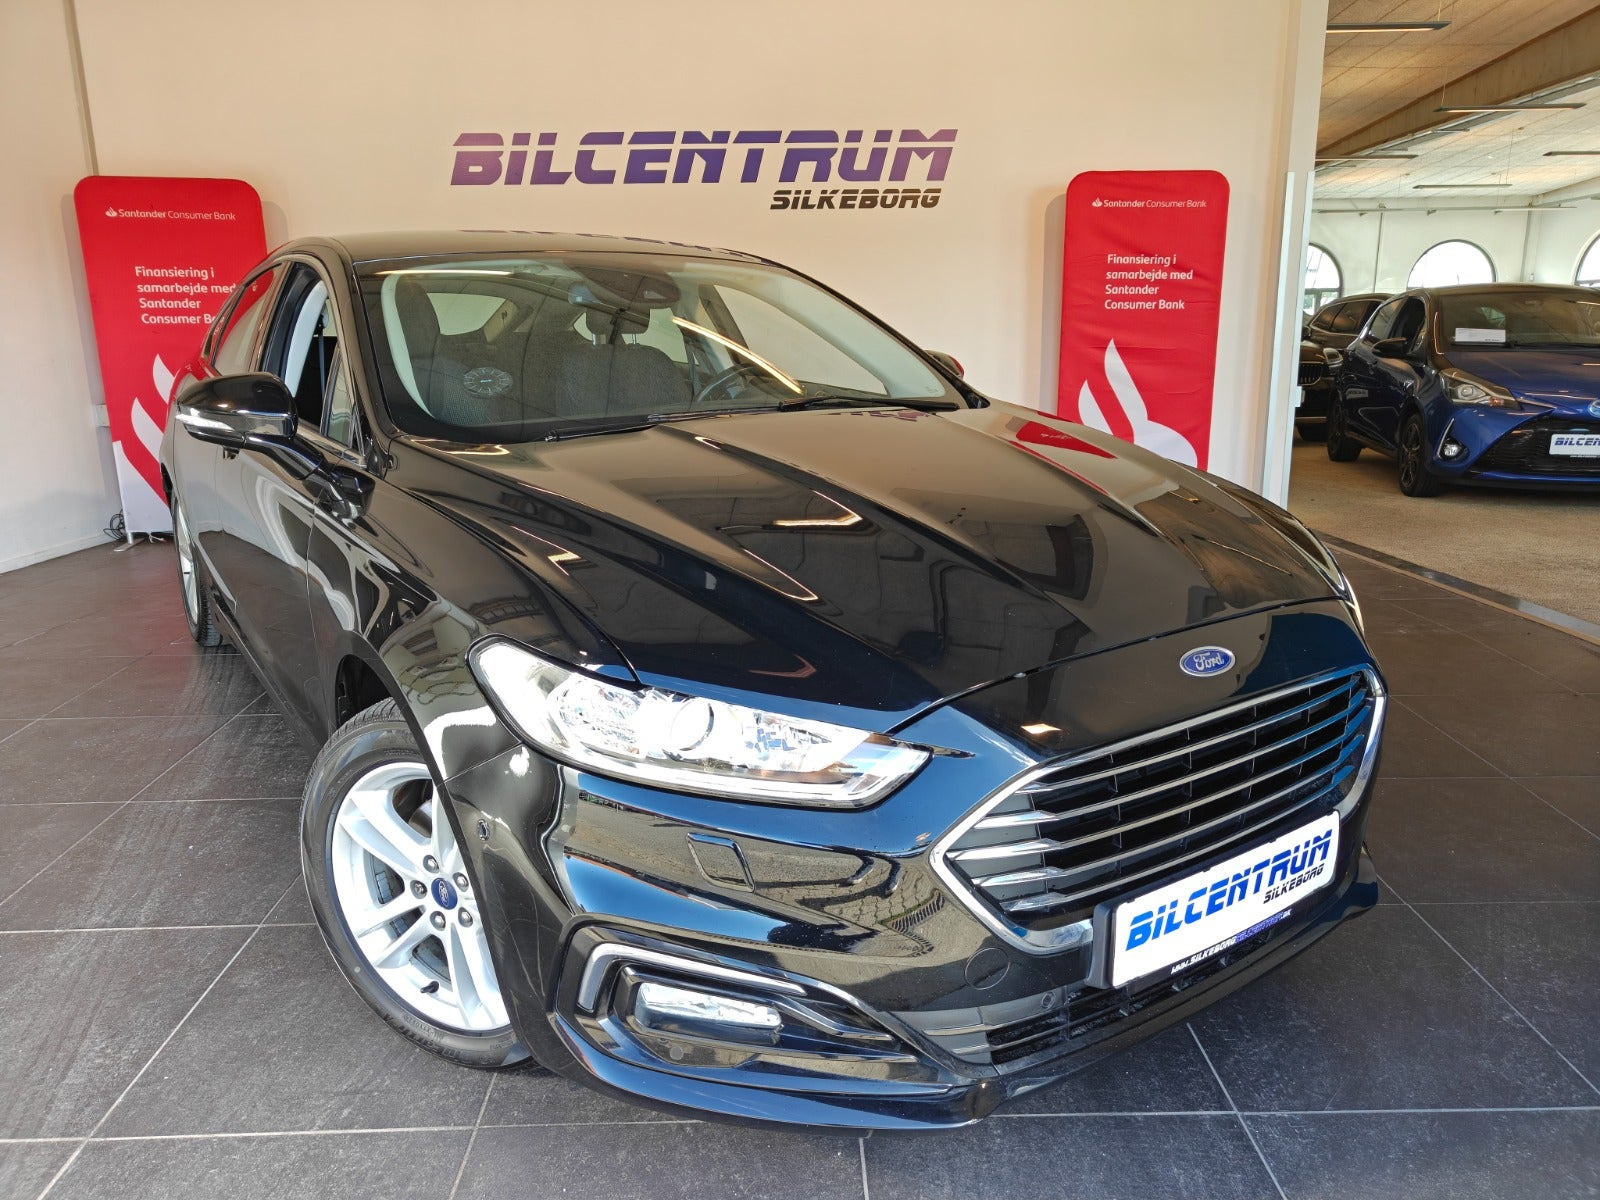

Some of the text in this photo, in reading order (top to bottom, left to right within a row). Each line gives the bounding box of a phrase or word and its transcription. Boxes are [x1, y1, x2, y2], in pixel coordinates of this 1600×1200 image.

[450, 129, 959, 186] BILCENTRUM
[770, 188, 942, 210] SILKEBORG
[1103, 199, 1207, 208] Santander Consumer Bank
[118, 208, 236, 221] Santander Consumer Bank
[1107, 254, 1177, 267] Finansiering i
[134, 266, 215, 280] Finansiering i
[1105, 269, 1194, 282] samarbejde med
[136, 283, 208, 295] samarbejde
[1105, 284, 1159, 295] Santander
[138, 298, 201, 309] Santander
[1104, 299, 1185, 310] Consumer Bank
[141, 313, 201, 324] Consumer
[1193, 652, 1225, 671] Ford
[1263, 863, 1325, 904] SILKEBORG
[1125, 829, 1333, 952] BILCENTRUM
